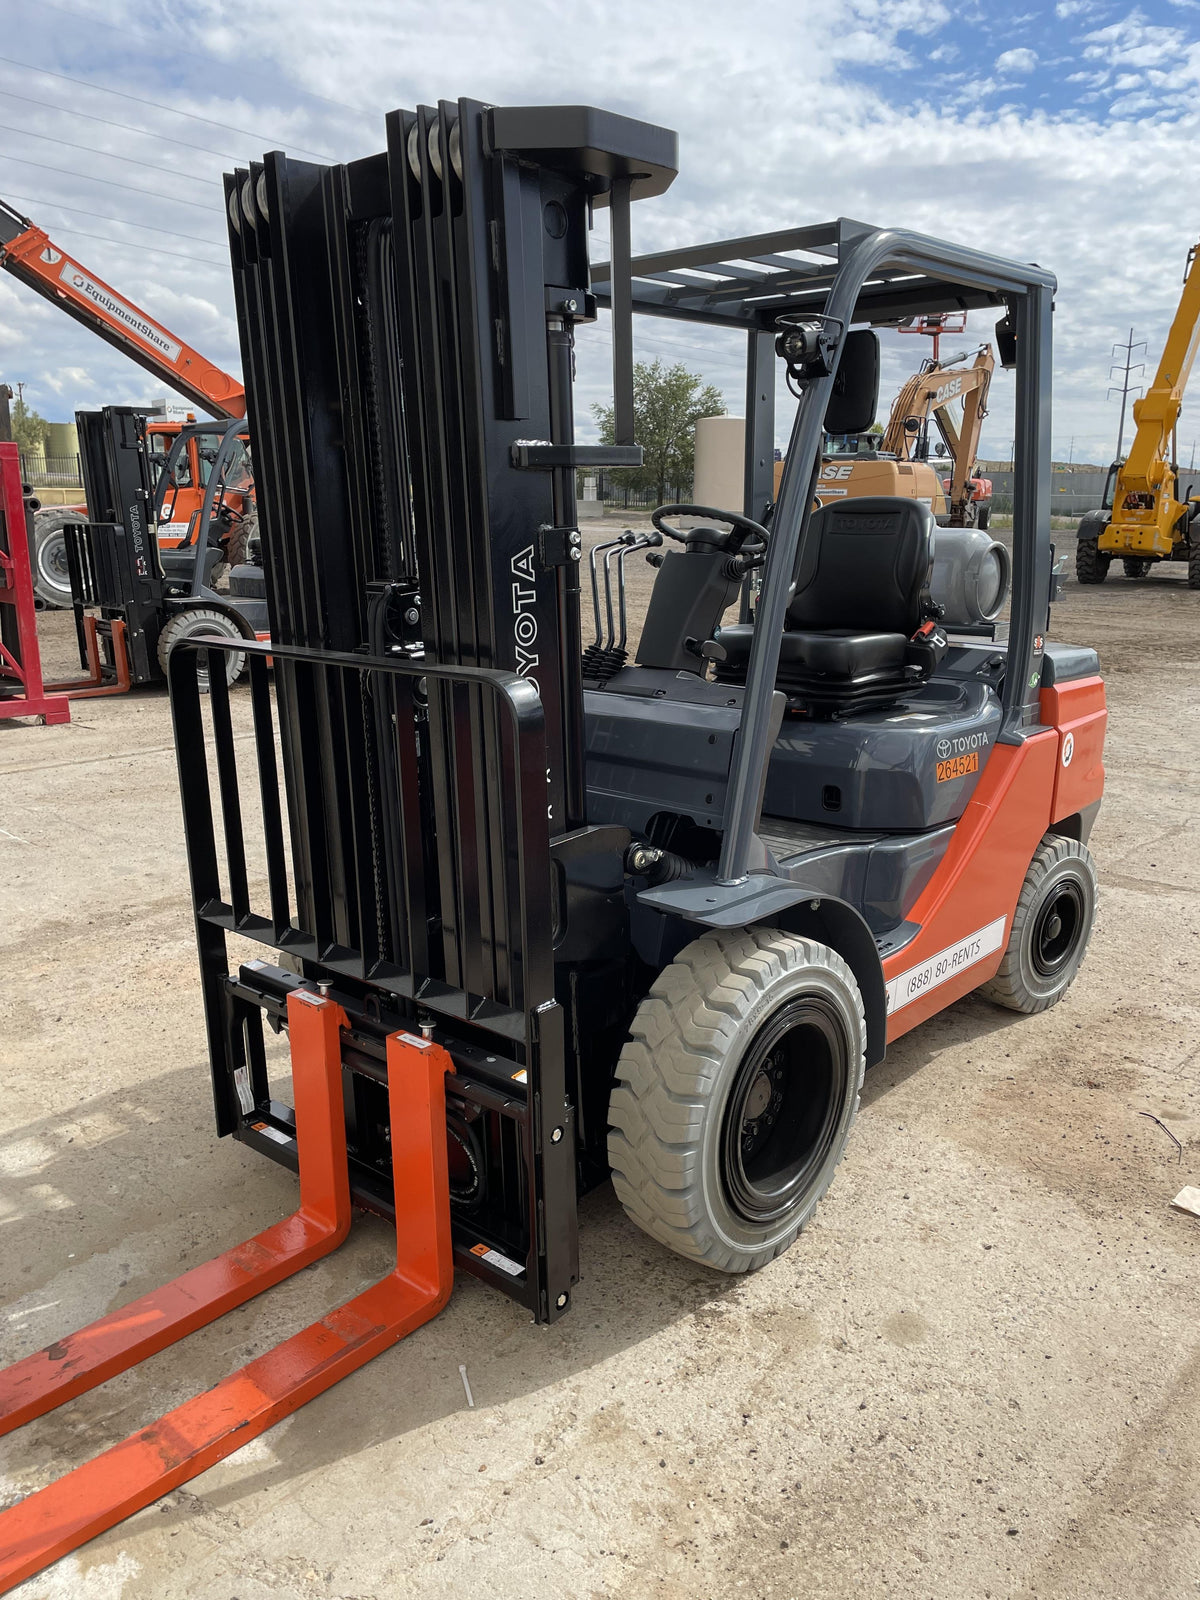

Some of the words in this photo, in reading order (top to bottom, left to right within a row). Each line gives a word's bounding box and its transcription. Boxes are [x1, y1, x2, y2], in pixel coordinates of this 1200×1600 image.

[84, 283, 170, 352] EquipmentShare
[936, 376, 962, 404] CASE
[129, 504, 144, 553] TOYOTA
[510, 544, 541, 697] YOTA
[952, 731, 989, 753] TOYOTA
[937, 753, 977, 782] 264521
[906, 966, 933, 998] (888)
[935, 938, 981, 978] 80-RENTS
